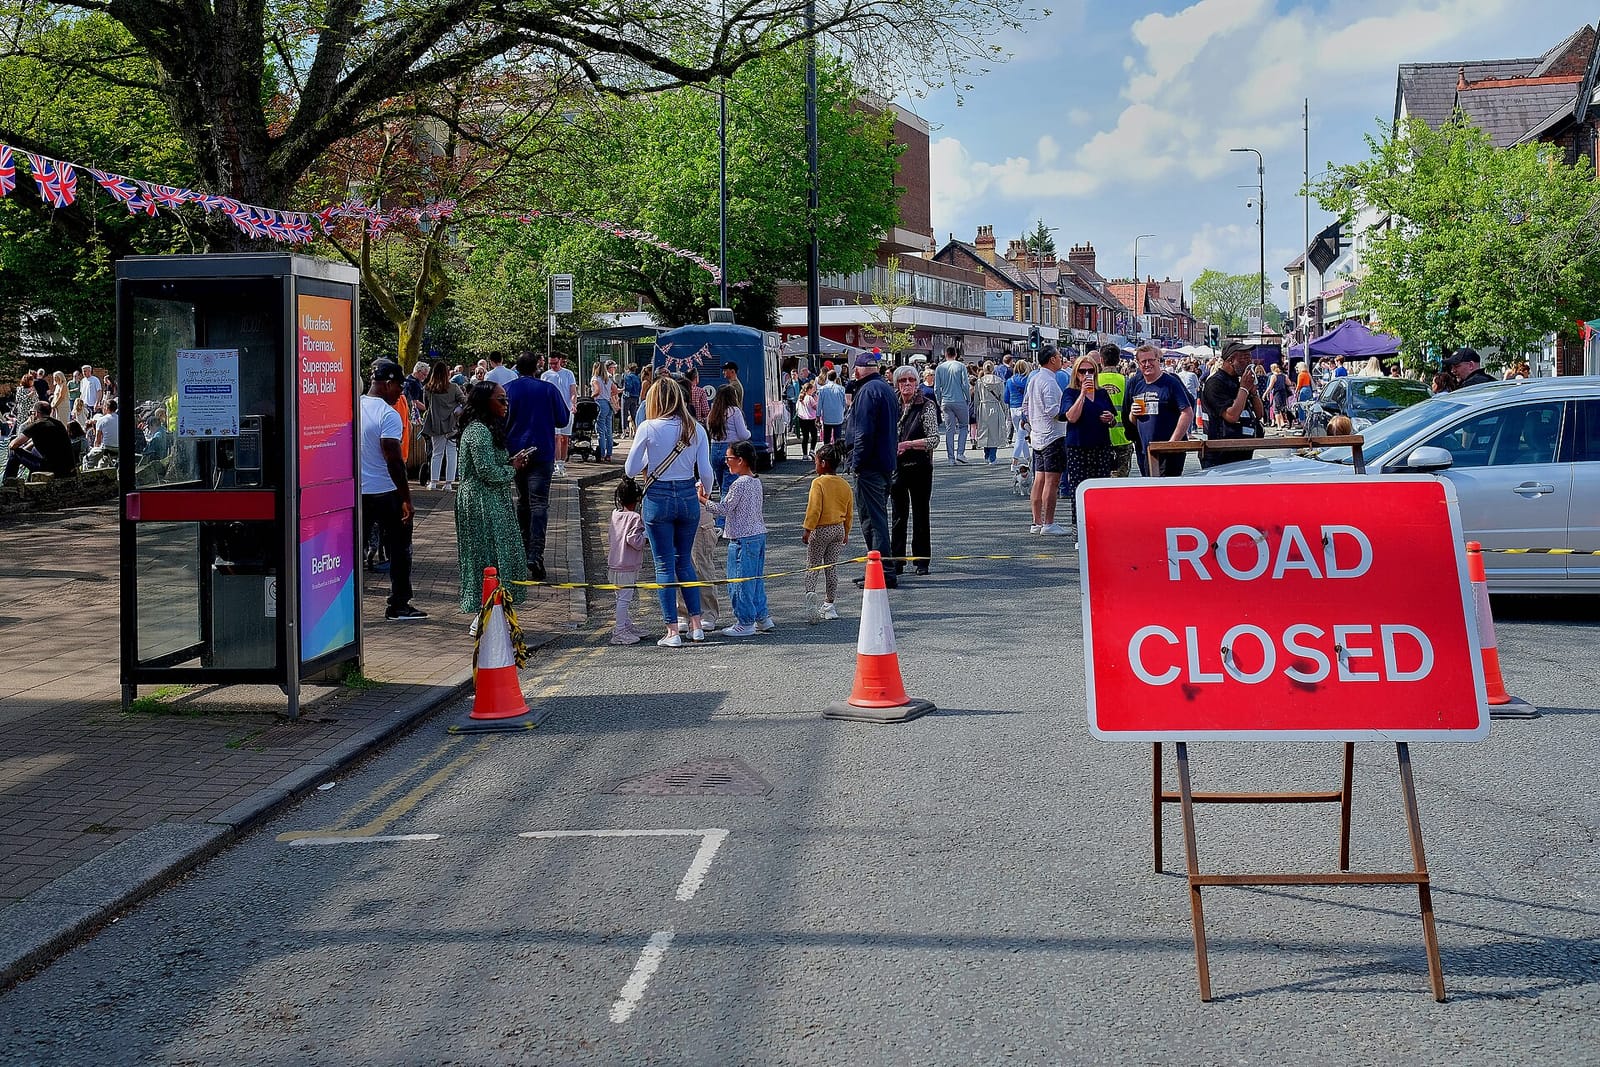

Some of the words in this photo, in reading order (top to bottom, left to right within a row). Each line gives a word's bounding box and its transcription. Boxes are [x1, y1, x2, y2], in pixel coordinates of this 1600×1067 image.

[302, 314, 333, 331] Ultrafast.
[302, 335, 336, 352] Fibremax.
[302, 357, 344, 377] Superspeed.
[303, 378, 319, 396] Blah,
[320, 377, 337, 394] blah!
[1165, 524, 1373, 581] ROAD
[312, 554, 341, 575] BeFibre
[1128, 624, 1435, 686] CLOSED
